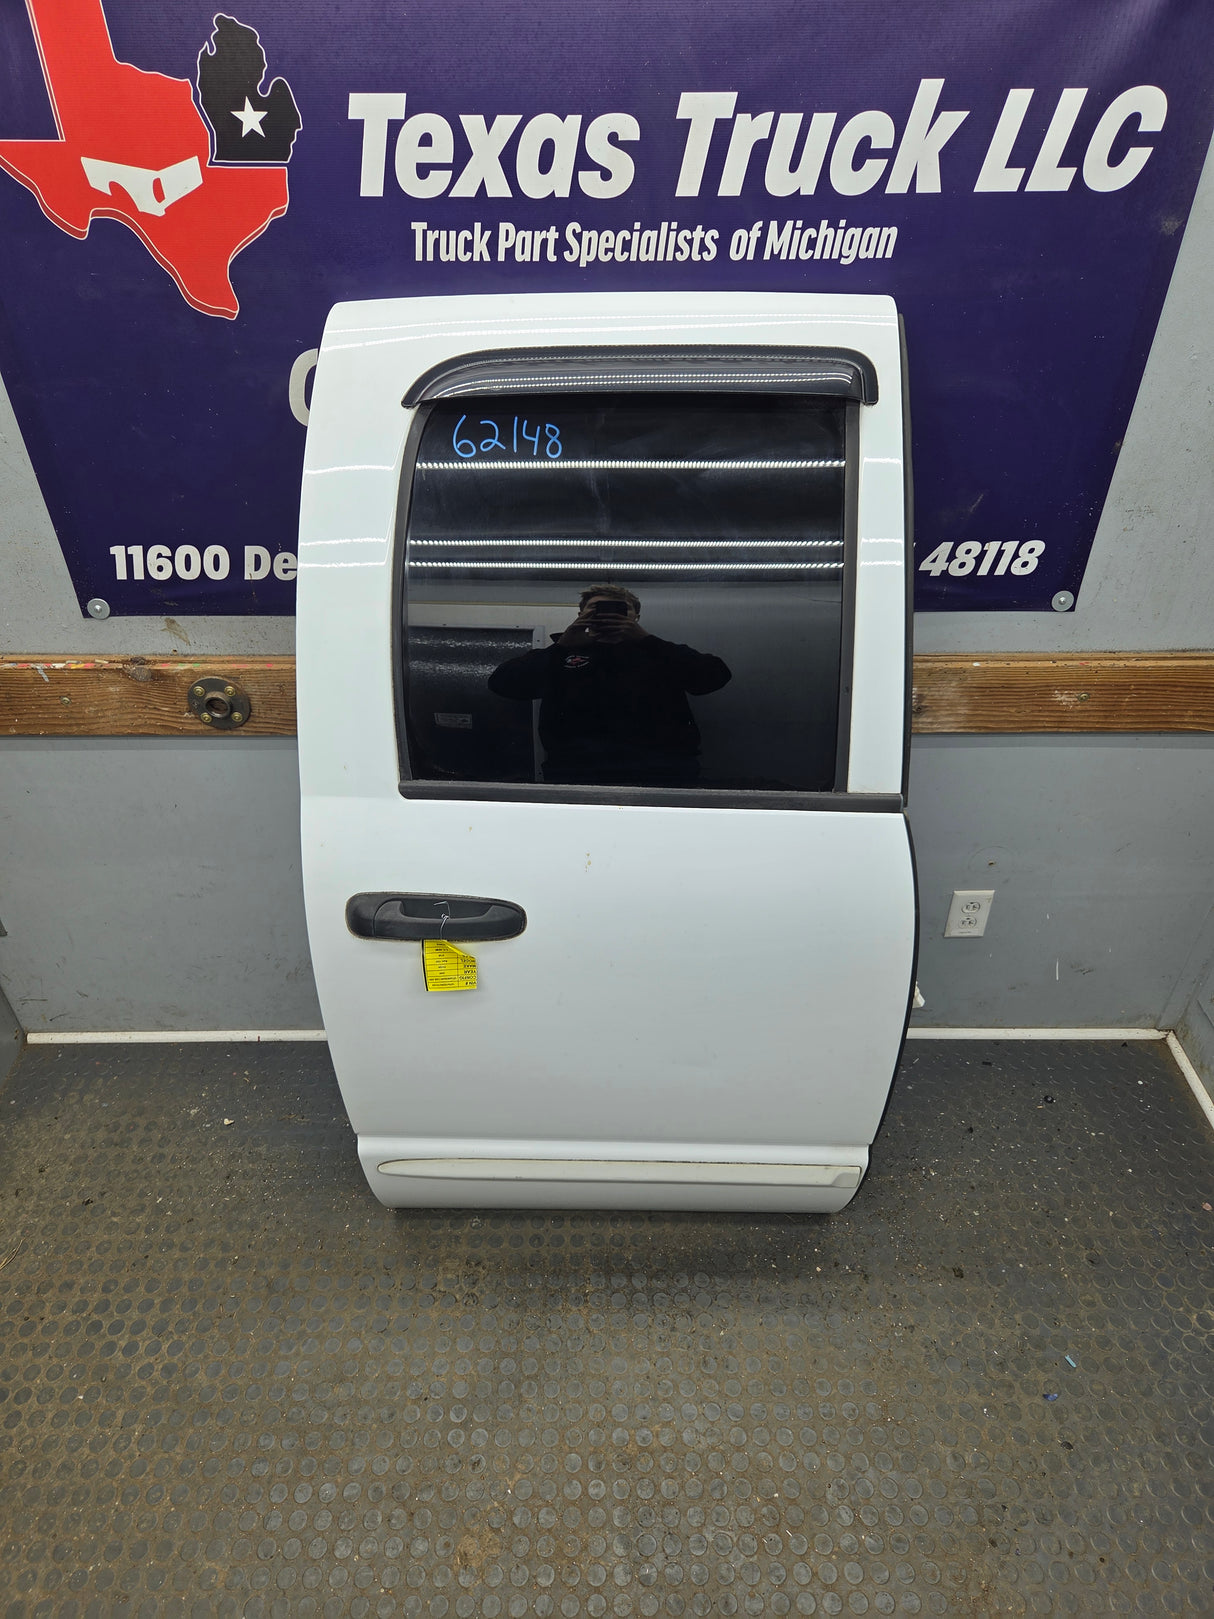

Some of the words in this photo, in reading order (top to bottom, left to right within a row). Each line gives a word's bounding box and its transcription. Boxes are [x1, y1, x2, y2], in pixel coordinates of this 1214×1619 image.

[347, 92, 641, 200] Texas
[674, 78, 971, 197] Truck
[974, 84, 1168, 193] LLC
[410, 221, 492, 262] Truck
[497, 222, 560, 263] Part
[563, 221, 720, 268] Specialists
[729, 220, 764, 262] of
[763, 219, 899, 265] Michigan
[452, 414, 563, 459] 62148
[109, 544, 231, 581] 11600
[918, 539, 1046, 577] 48118
